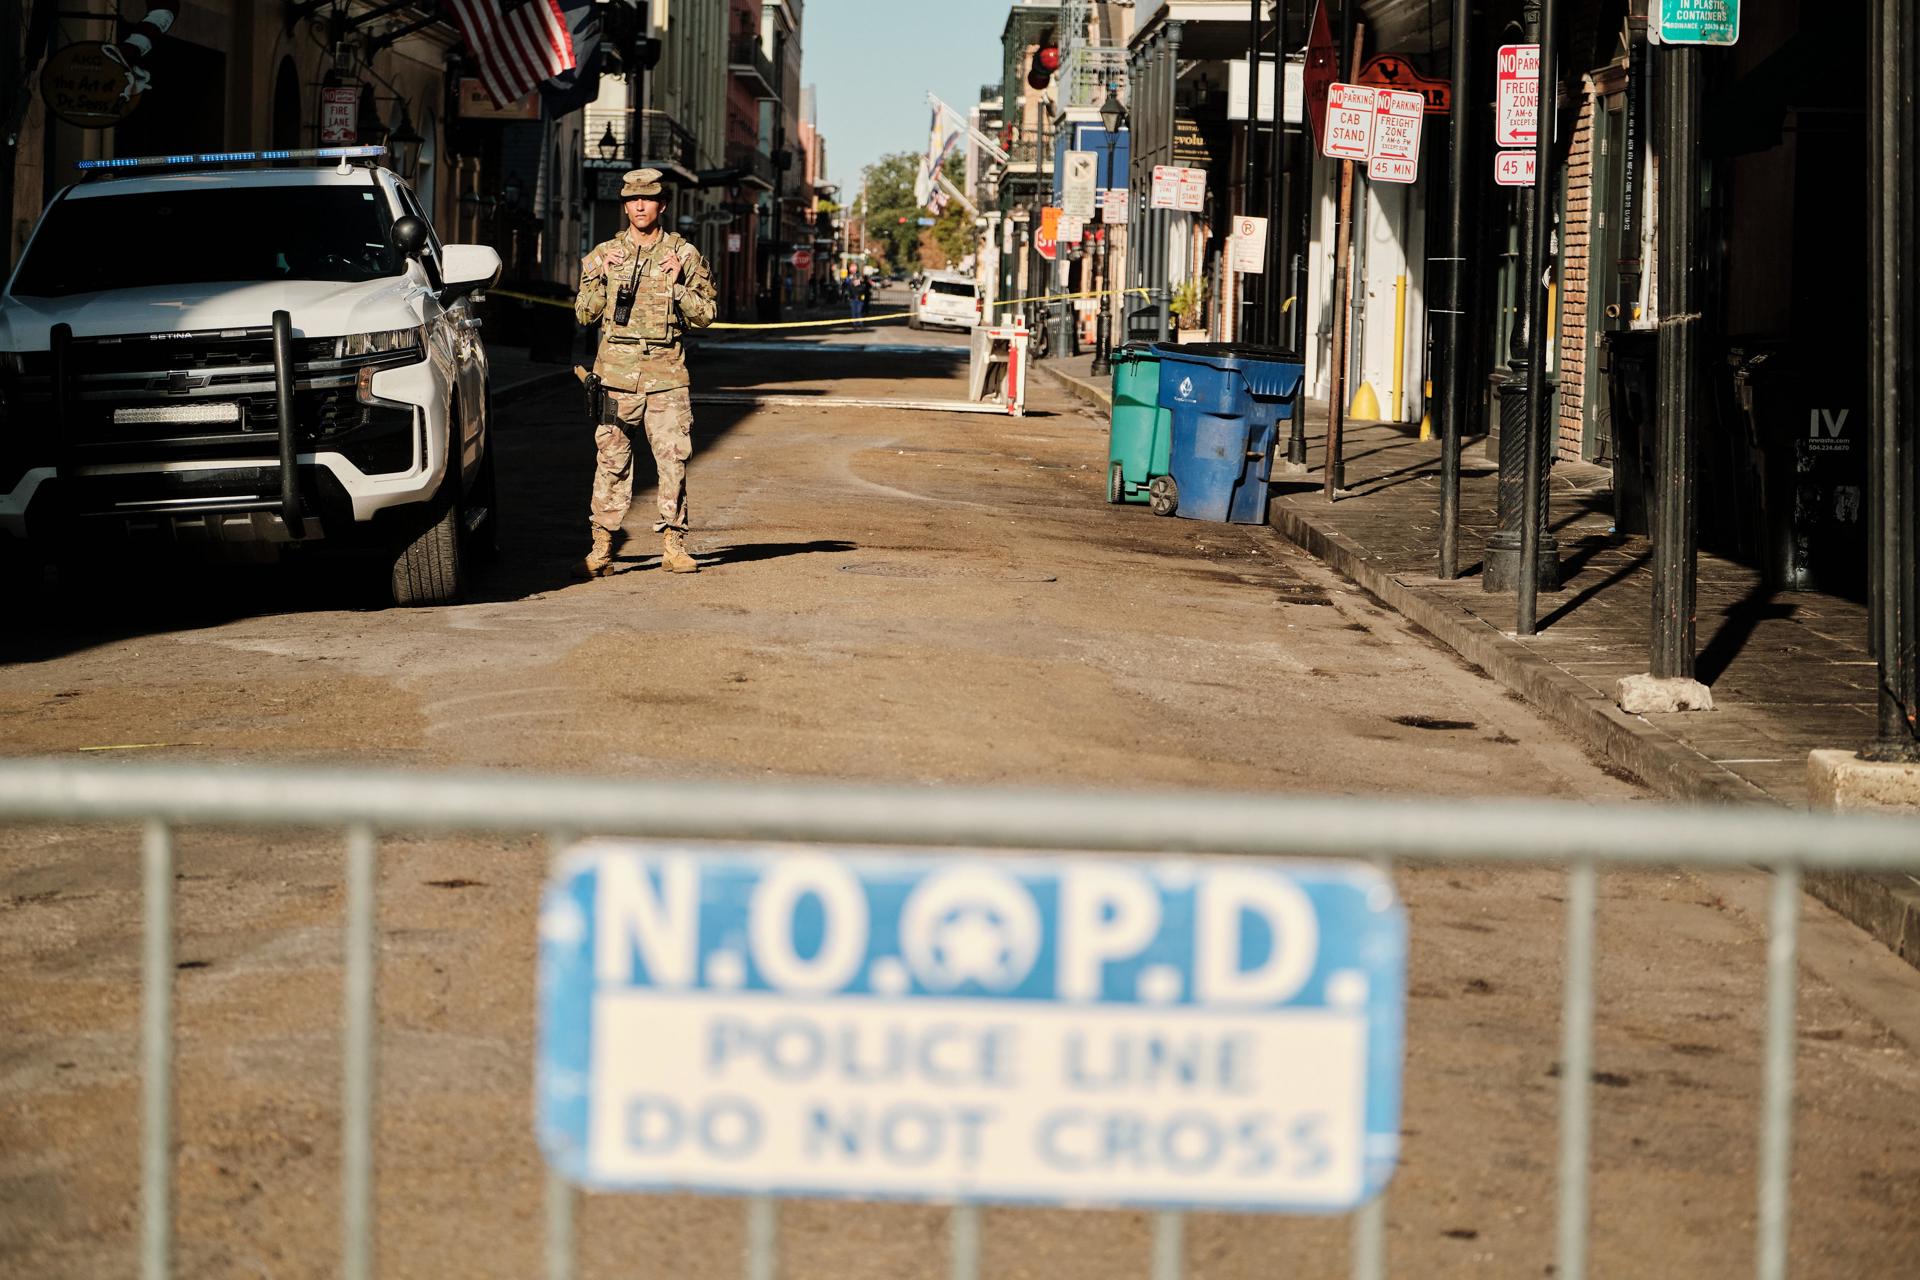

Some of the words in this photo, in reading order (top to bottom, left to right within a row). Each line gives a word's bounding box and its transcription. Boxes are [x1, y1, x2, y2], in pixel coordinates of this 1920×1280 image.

[1693, 0, 1726, 10] PLASTIC
[1676, 10, 1728, 21] CONTAINERS
[1500, 54, 1516, 73] NO
[1517, 58, 1539, 70] PARK
[1506, 82, 1539, 94] FREIG
[1330, 89, 1344, 104] NO
[1344, 92, 1374, 105] PARKING
[1377, 93, 1391, 110] NO
[1391, 99, 1420, 113] PARKING
[330, 105, 349, 115] FIRE
[1507, 109, 1511, 119] 7
[1515, 109, 1532, 117] AM-6
[328, 117, 350, 128] LANE
[1340, 112, 1361, 125] CAB
[1380, 115, 1415, 129] FREIGHT
[1333, 127, 1365, 141] STAND
[1385, 126, 1408, 138] ZONE
[1174, 133, 1205, 146] evolu
[1375, 162, 1388, 173] 45
[1394, 163, 1412, 175] MIN
[1503, 161, 1518, 175] 45
[150, 332, 193, 341] SETINA
[1810, 408, 1850, 438] IV
[708, 1014, 1020, 1090] POLICE
[1062, 1026, 1260, 1098] LINE
[626, 1091, 767, 1161] DO
[804, 1100, 1002, 1168] NOT
[1033, 1107, 1335, 1180] CROSS
